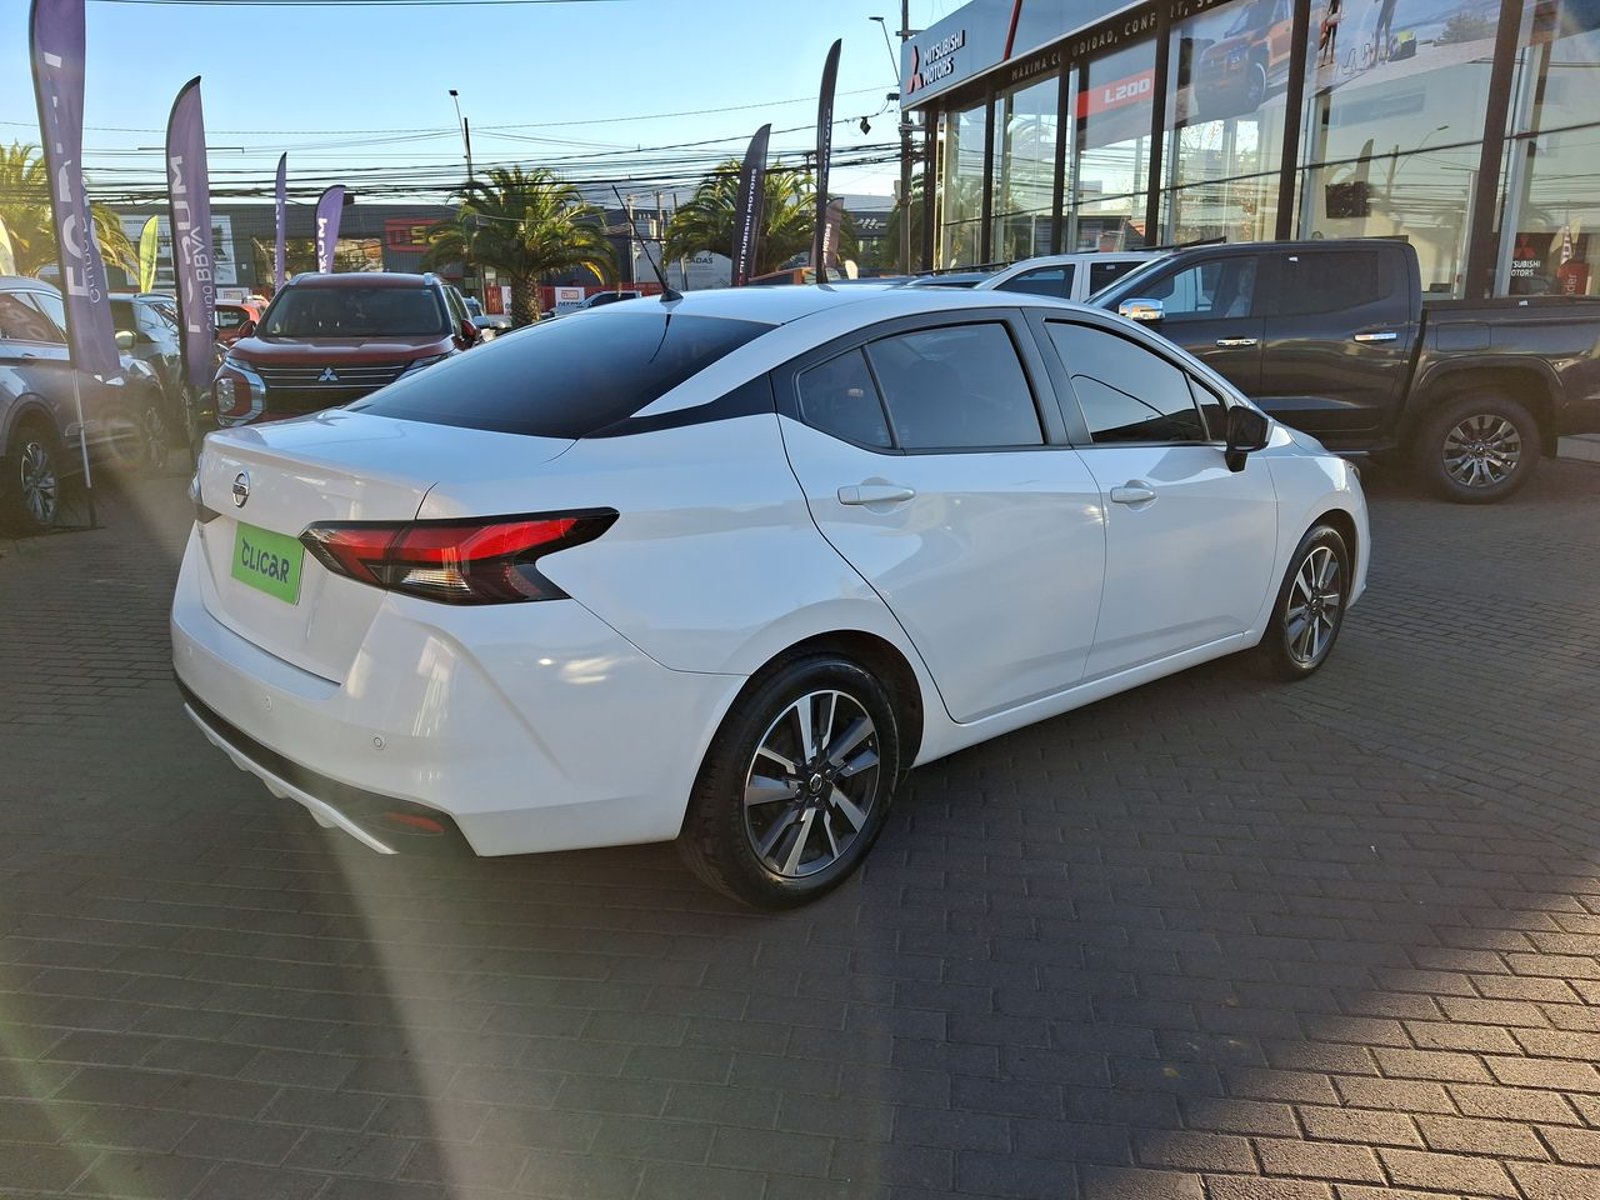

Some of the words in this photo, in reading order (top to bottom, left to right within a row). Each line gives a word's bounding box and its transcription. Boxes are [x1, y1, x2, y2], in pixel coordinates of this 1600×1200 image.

[924, 30, 965, 66] MITSUBISHI
[923, 56, 954, 86] MOTORS
[1104, 78, 1151, 104] L200
[747, 168, 757, 213] MOTORS
[189, 226, 212, 281] BBVA
[1510, 268, 1535, 277] OTORS
